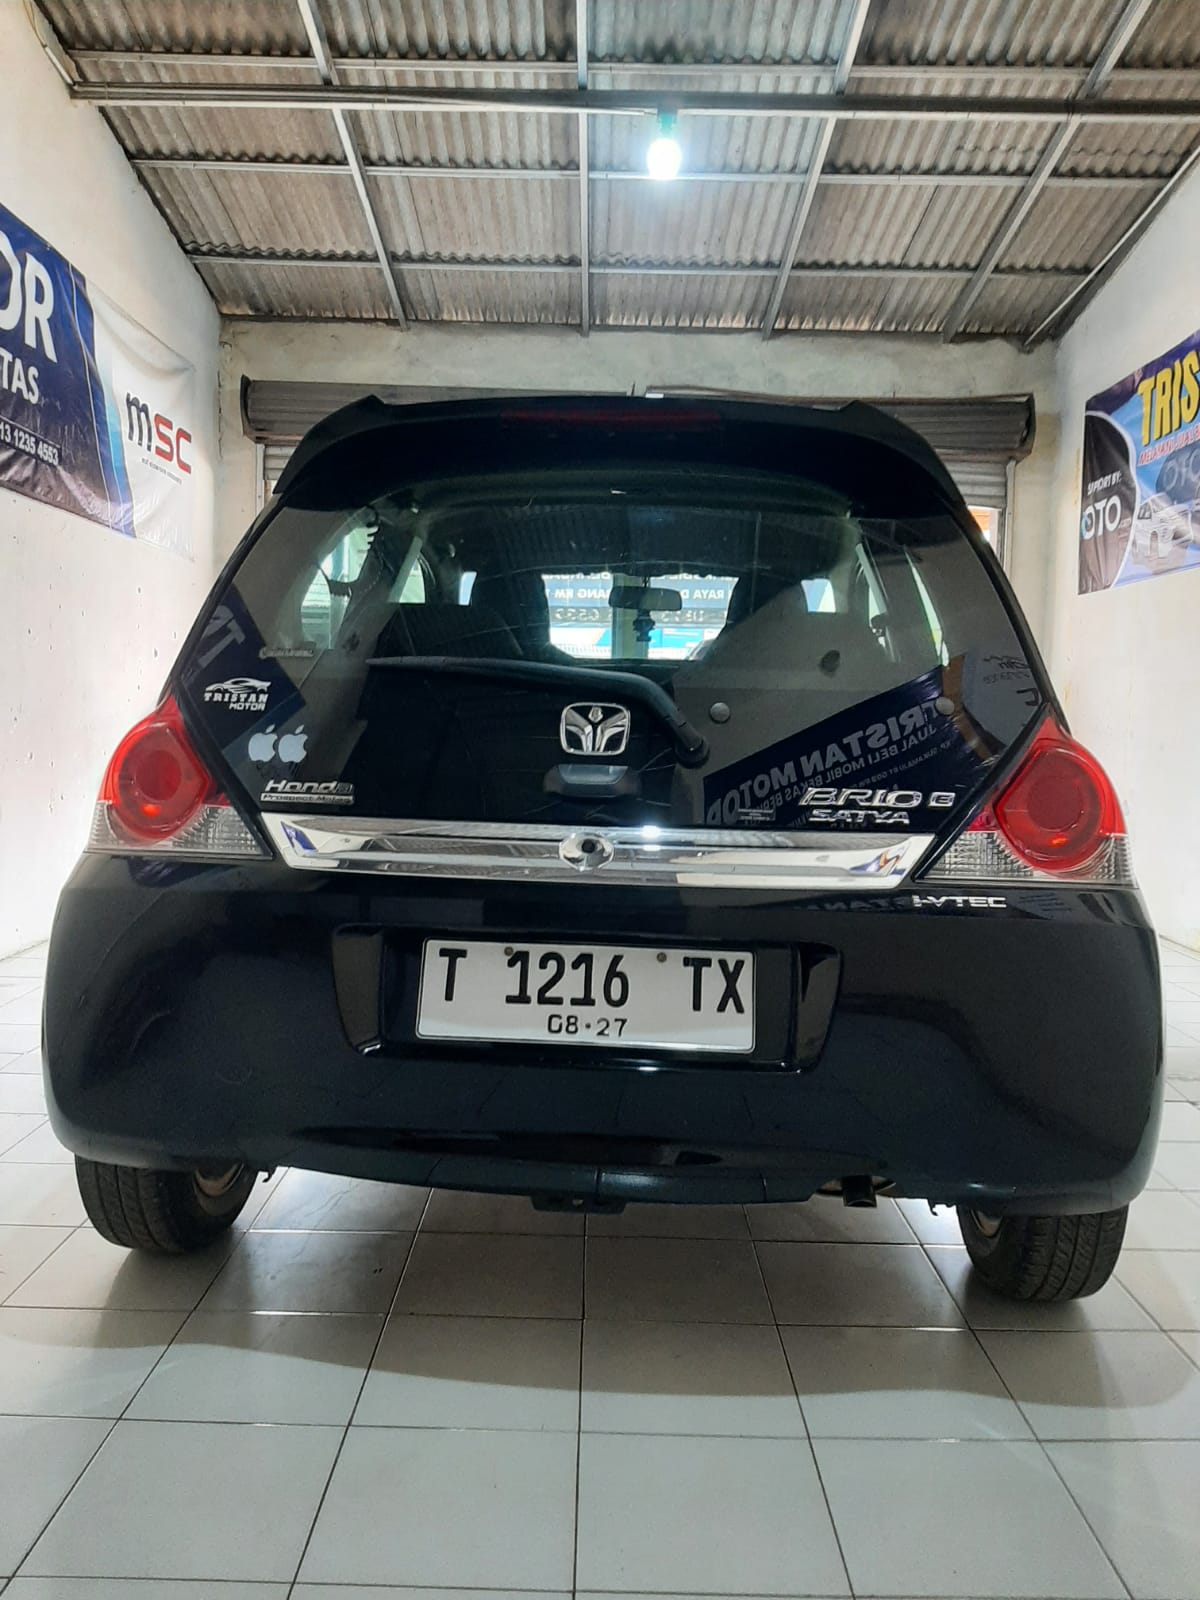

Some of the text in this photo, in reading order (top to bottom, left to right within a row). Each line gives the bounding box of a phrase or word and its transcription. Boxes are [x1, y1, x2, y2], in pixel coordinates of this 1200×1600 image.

[0, 347, 39, 404] TAS
[1138, 350, 1200, 446] TRIS
[14, 429, 36, 454] 1235
[1081, 495, 1122, 540] OTO
[203, 692, 269, 703] TRISTAN
[229, 702, 266, 711] MOTOR
[799, 787, 923, 808] BRIO
[808, 808, 911, 825] SATYA
[438, 947, 746, 1014] T 1216 TX
